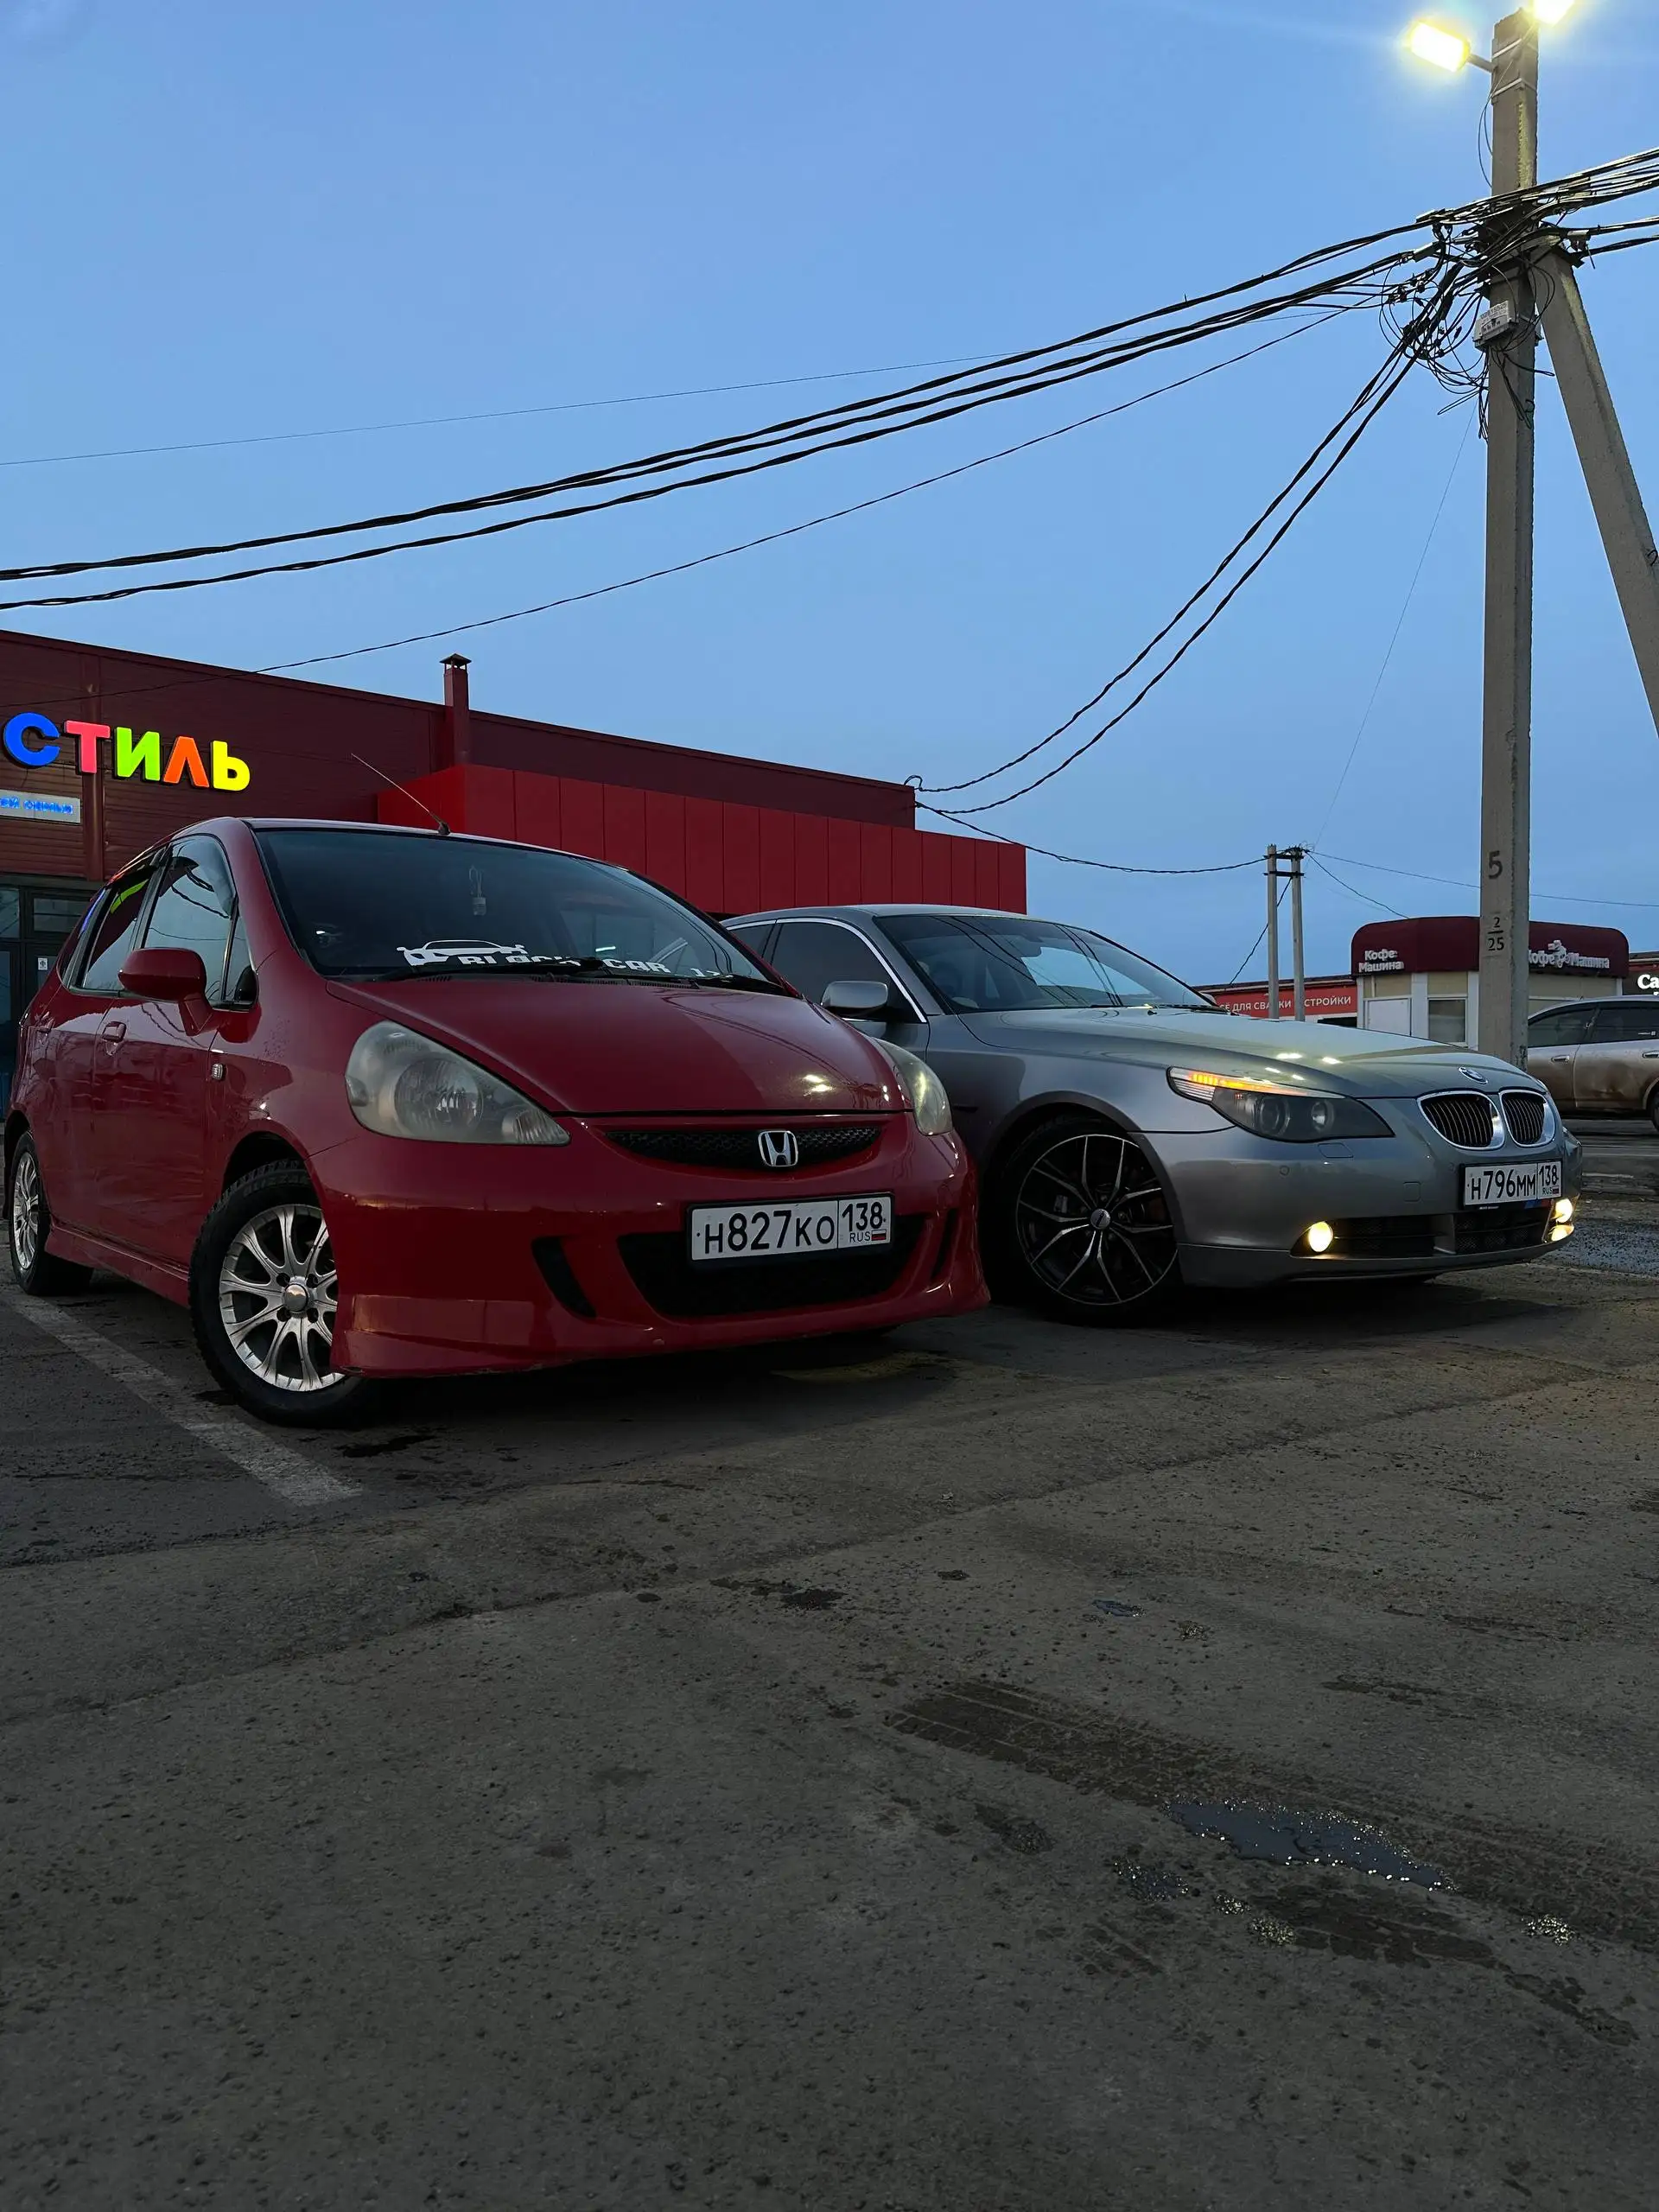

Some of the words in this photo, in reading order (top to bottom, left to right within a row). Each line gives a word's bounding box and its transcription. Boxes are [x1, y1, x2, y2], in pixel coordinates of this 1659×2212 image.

[3, 712, 251, 791] СТИЛЬ
[1488, 850, 1503, 880] 5
[1488, 937, 1504, 951] 25
[1365, 949, 1397, 961] Кофе
[602, 958, 671, 974] CAR
[1358, 961, 1404, 973] Машина
[1232, 1002, 1251, 1013] ДЛЯ
[1254, 1000, 1291, 1010] СВАКИ
[1304, 995, 1351, 1007] СТРОЙКИ
[1471, 1169, 1535, 1200] Н796ММ
[1539, 1164, 1558, 1186] 138
[704, 1210, 835, 1254] Н827КО
[842, 1201, 883, 1232] 138
[849, 1231, 871, 1243] RUS
